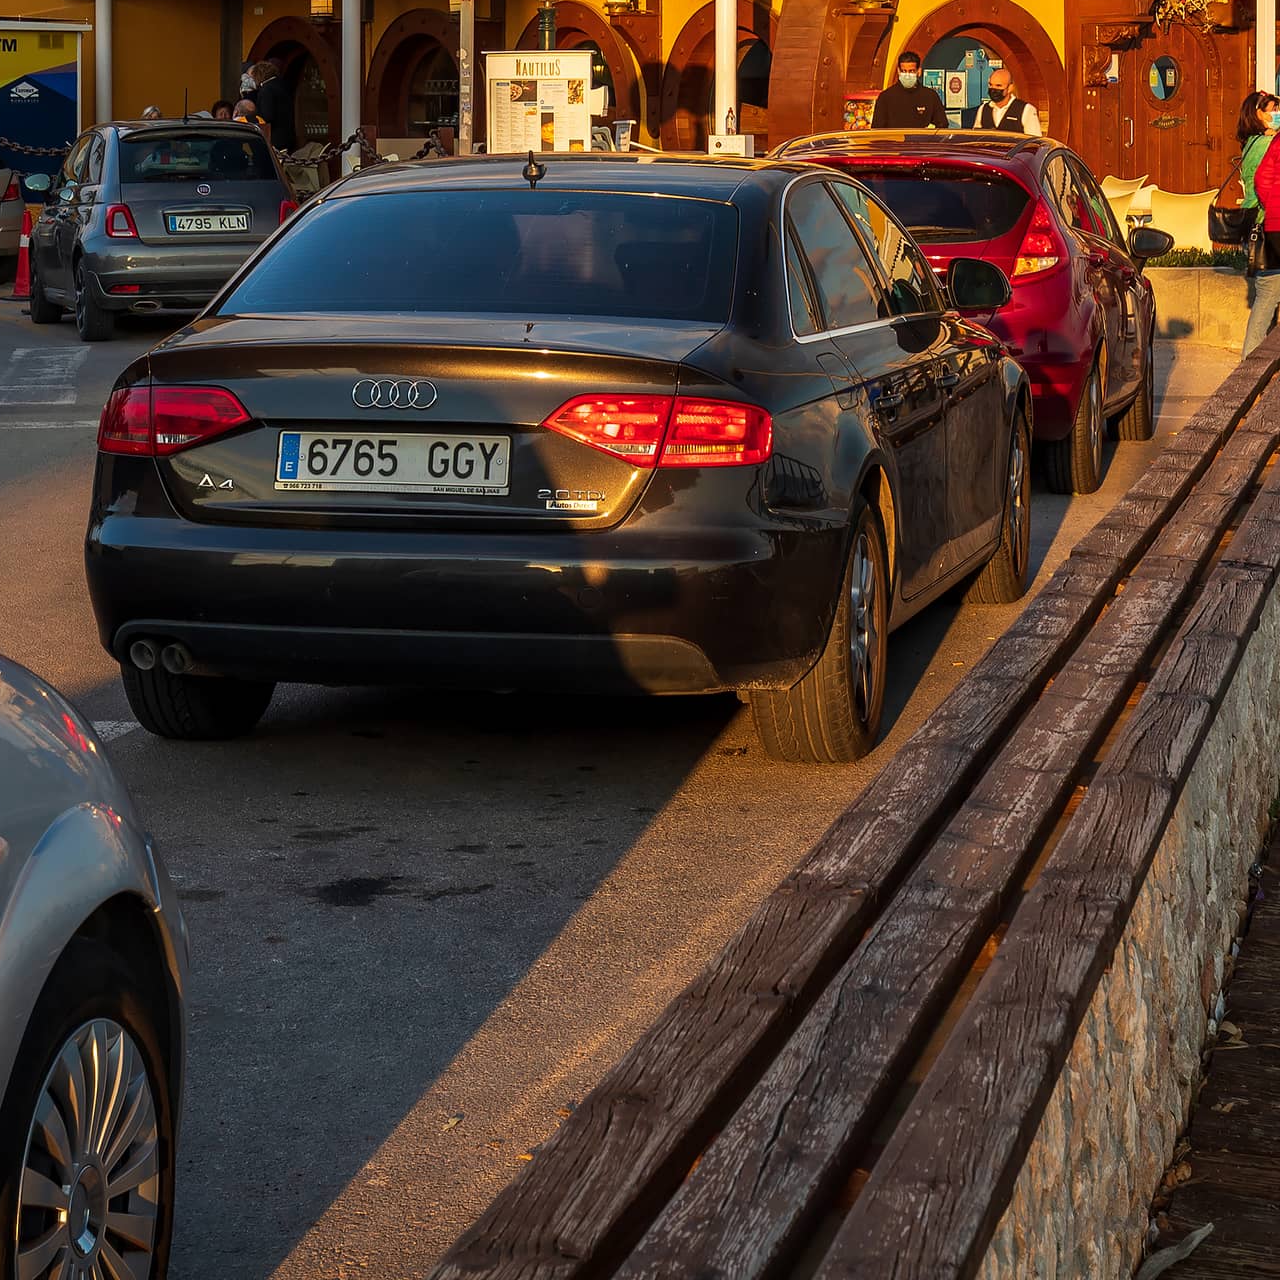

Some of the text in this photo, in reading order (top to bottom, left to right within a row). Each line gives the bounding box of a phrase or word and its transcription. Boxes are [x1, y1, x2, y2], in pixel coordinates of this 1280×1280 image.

[515, 59, 561, 77] NAUTILUS
[178, 216, 246, 230] 4795 KLN
[284, 461, 294, 472] E
[307, 438, 500, 481] 6765 GGY
[198, 473, 234, 491] A4
